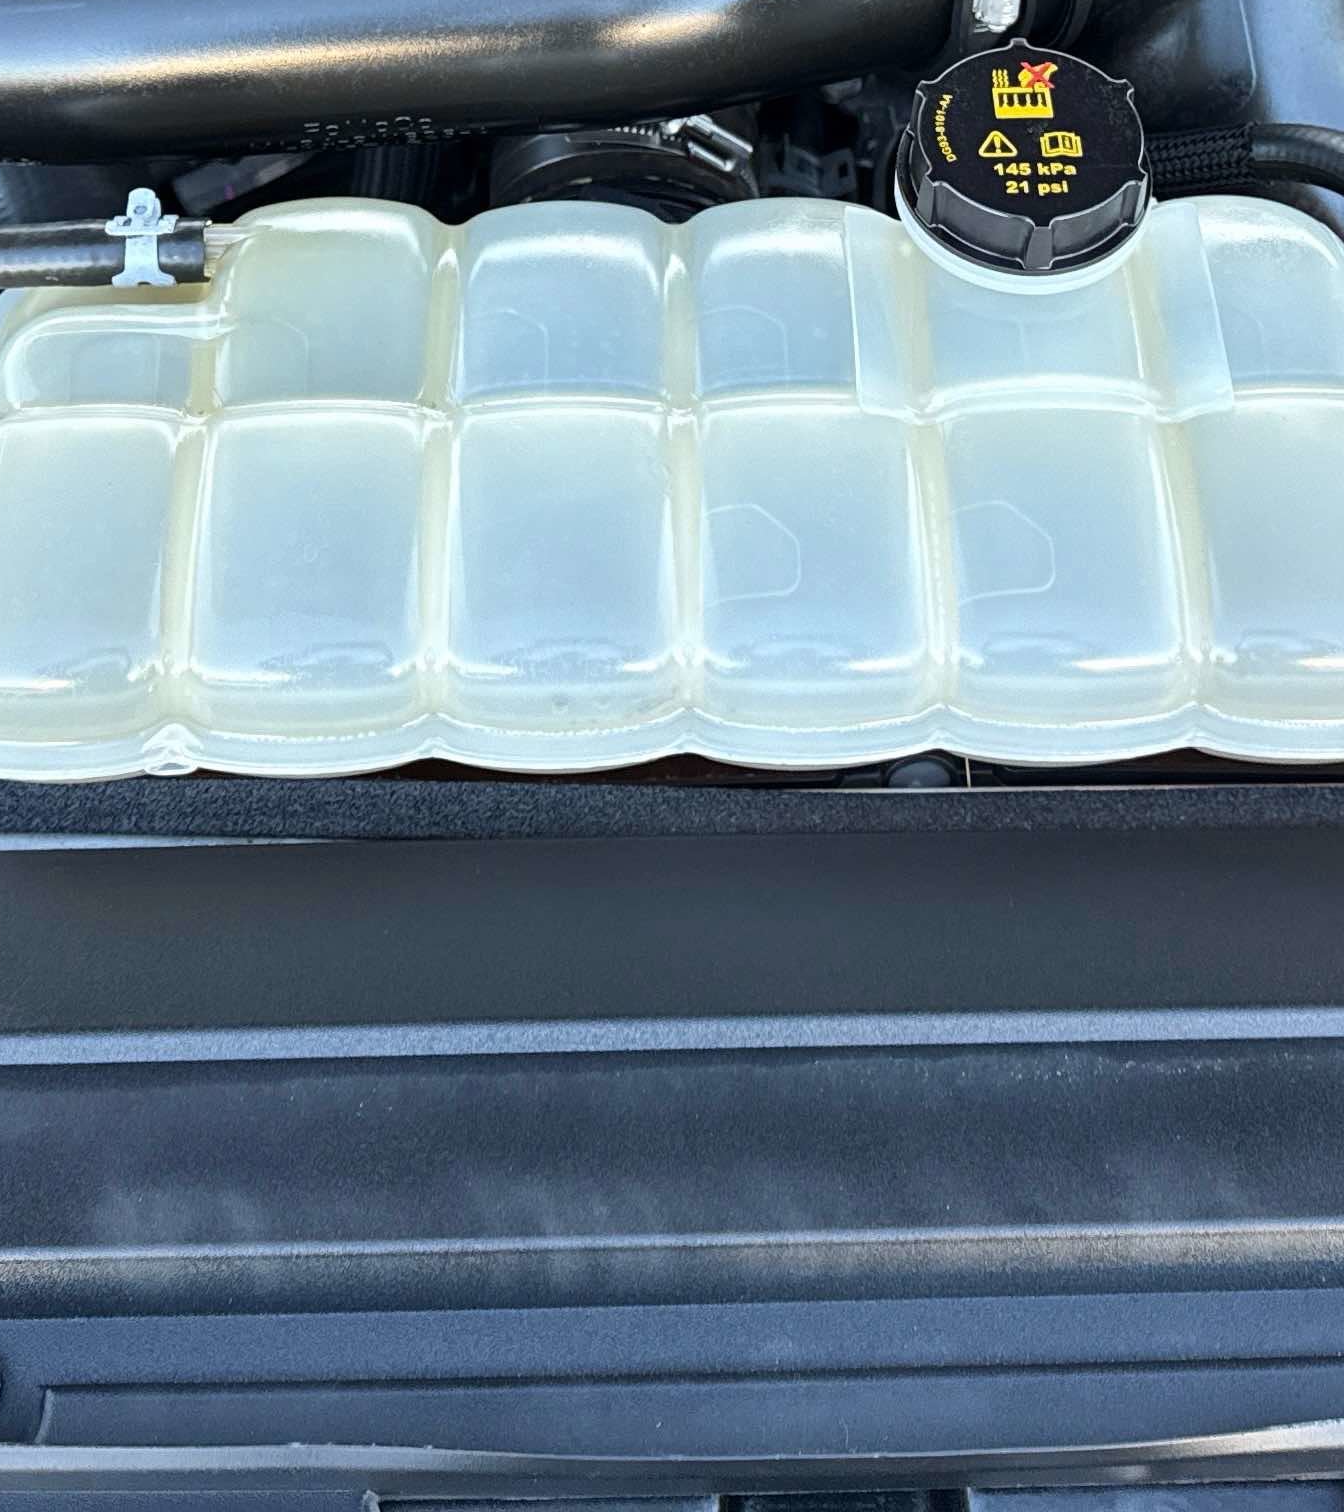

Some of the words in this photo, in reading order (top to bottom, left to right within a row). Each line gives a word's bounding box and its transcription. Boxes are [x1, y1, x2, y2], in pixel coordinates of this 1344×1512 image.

[993, 162, 1032, 176] 145
[1037, 162, 1077, 176] kPa
[1006, 180, 1030, 194] 21
[1038, 180, 1069, 197] psi
